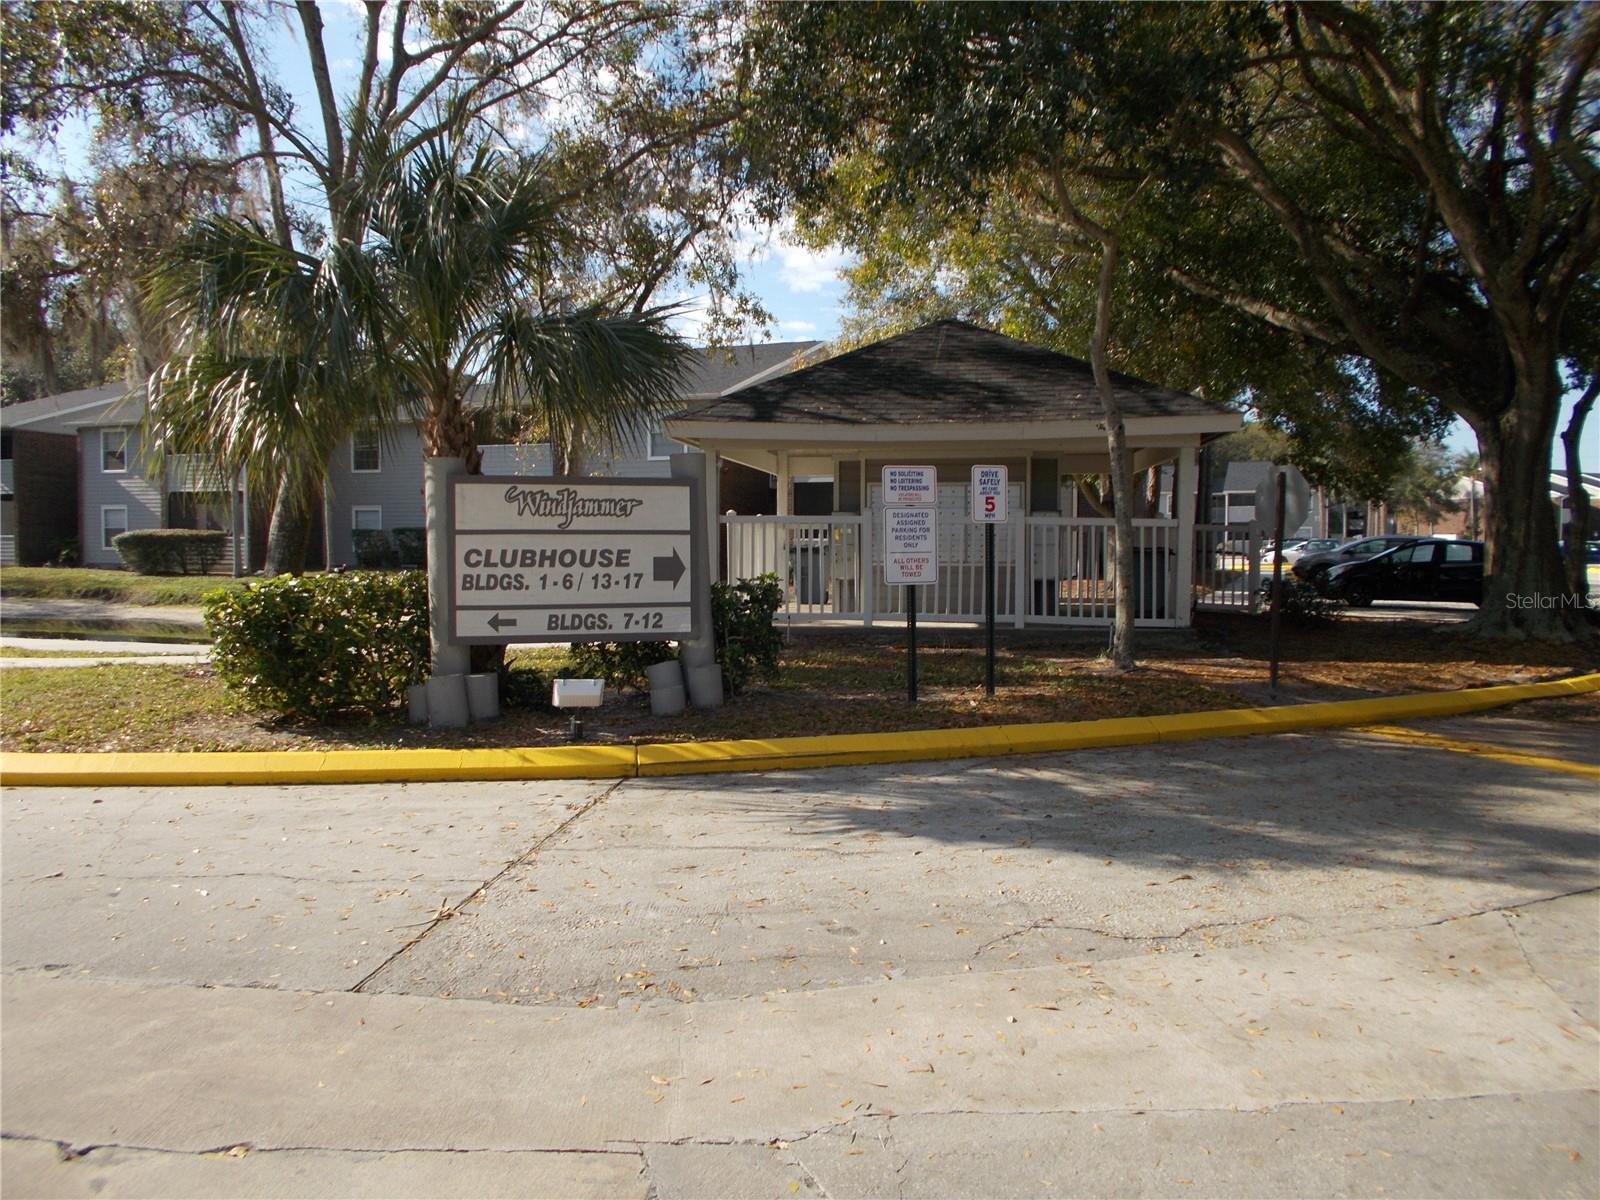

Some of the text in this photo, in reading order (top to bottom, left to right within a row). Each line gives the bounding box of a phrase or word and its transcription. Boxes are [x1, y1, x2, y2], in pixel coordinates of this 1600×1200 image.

[979, 478, 1001, 486] SAFELY
[980, 470, 999, 478] DRIVE
[984, 496, 996, 512] 5
[463, 548, 632, 568] CLUBHOUSE
[461, 573, 530, 592] BLDGS.
[547, 613, 613, 631] BLDGS.
